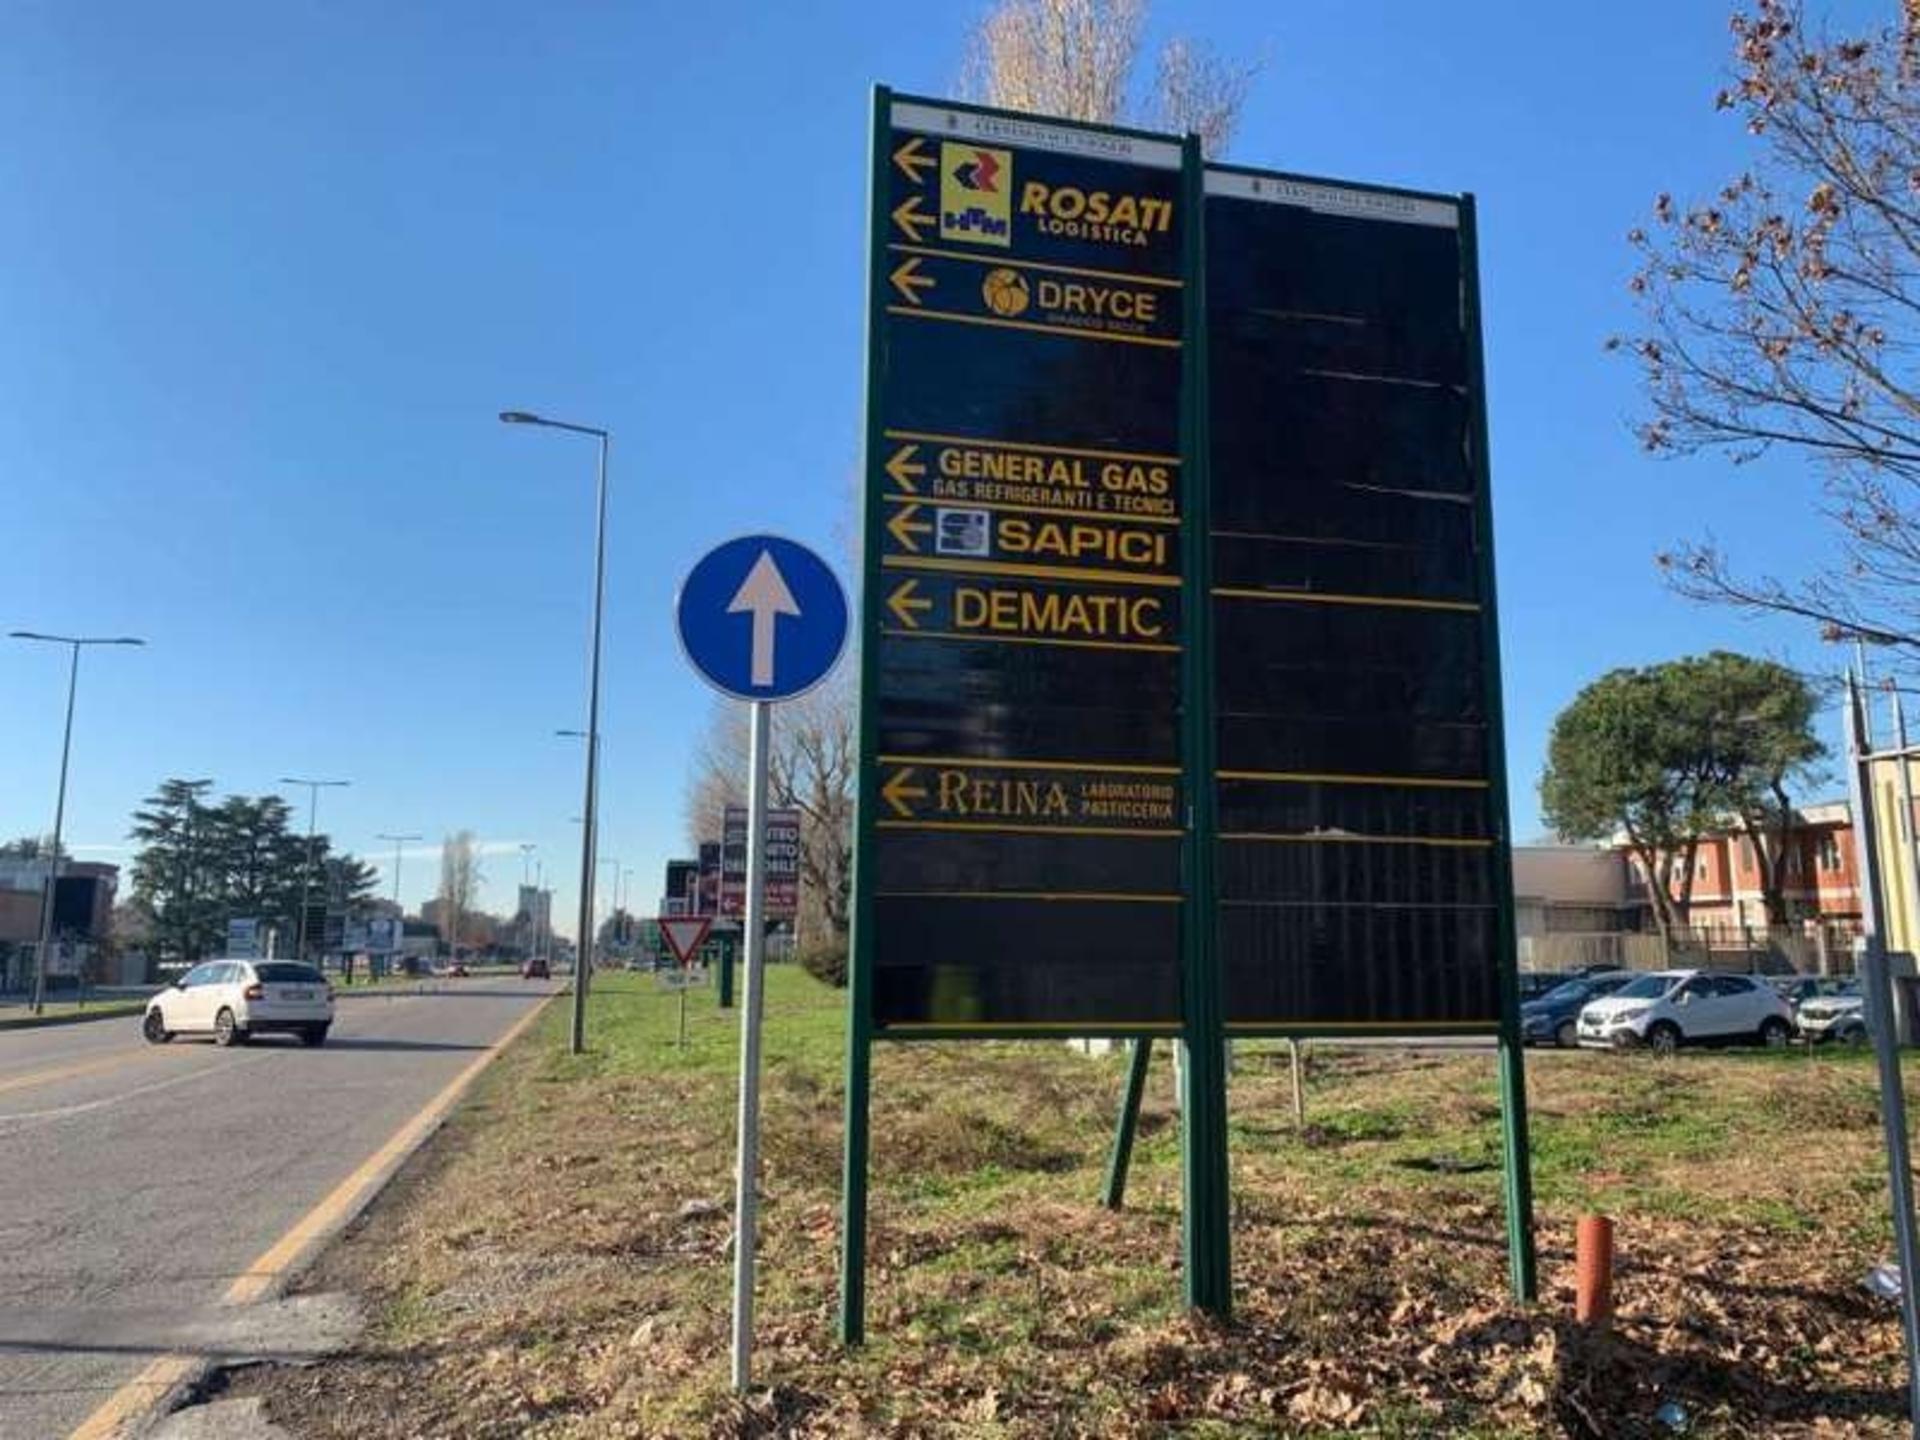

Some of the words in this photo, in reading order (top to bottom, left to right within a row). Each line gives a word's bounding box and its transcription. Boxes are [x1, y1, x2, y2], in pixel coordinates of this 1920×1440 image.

[1020, 180, 1174, 233] ROSATI
[1038, 219, 1148, 247] LOGISTICA
[1038, 280, 1158, 320] DRYCE
[932, 479, 968, 498] GAS
[975, 482, 1093, 508] REFRIGERANTI
[939, 449, 1091, 488] GENERAL
[1102, 465, 1170, 493] GAS
[997, 519, 1166, 565] SAPICI
[954, 587, 1163, 637] DEMATIC
[938, 768, 1071, 817] REINA
